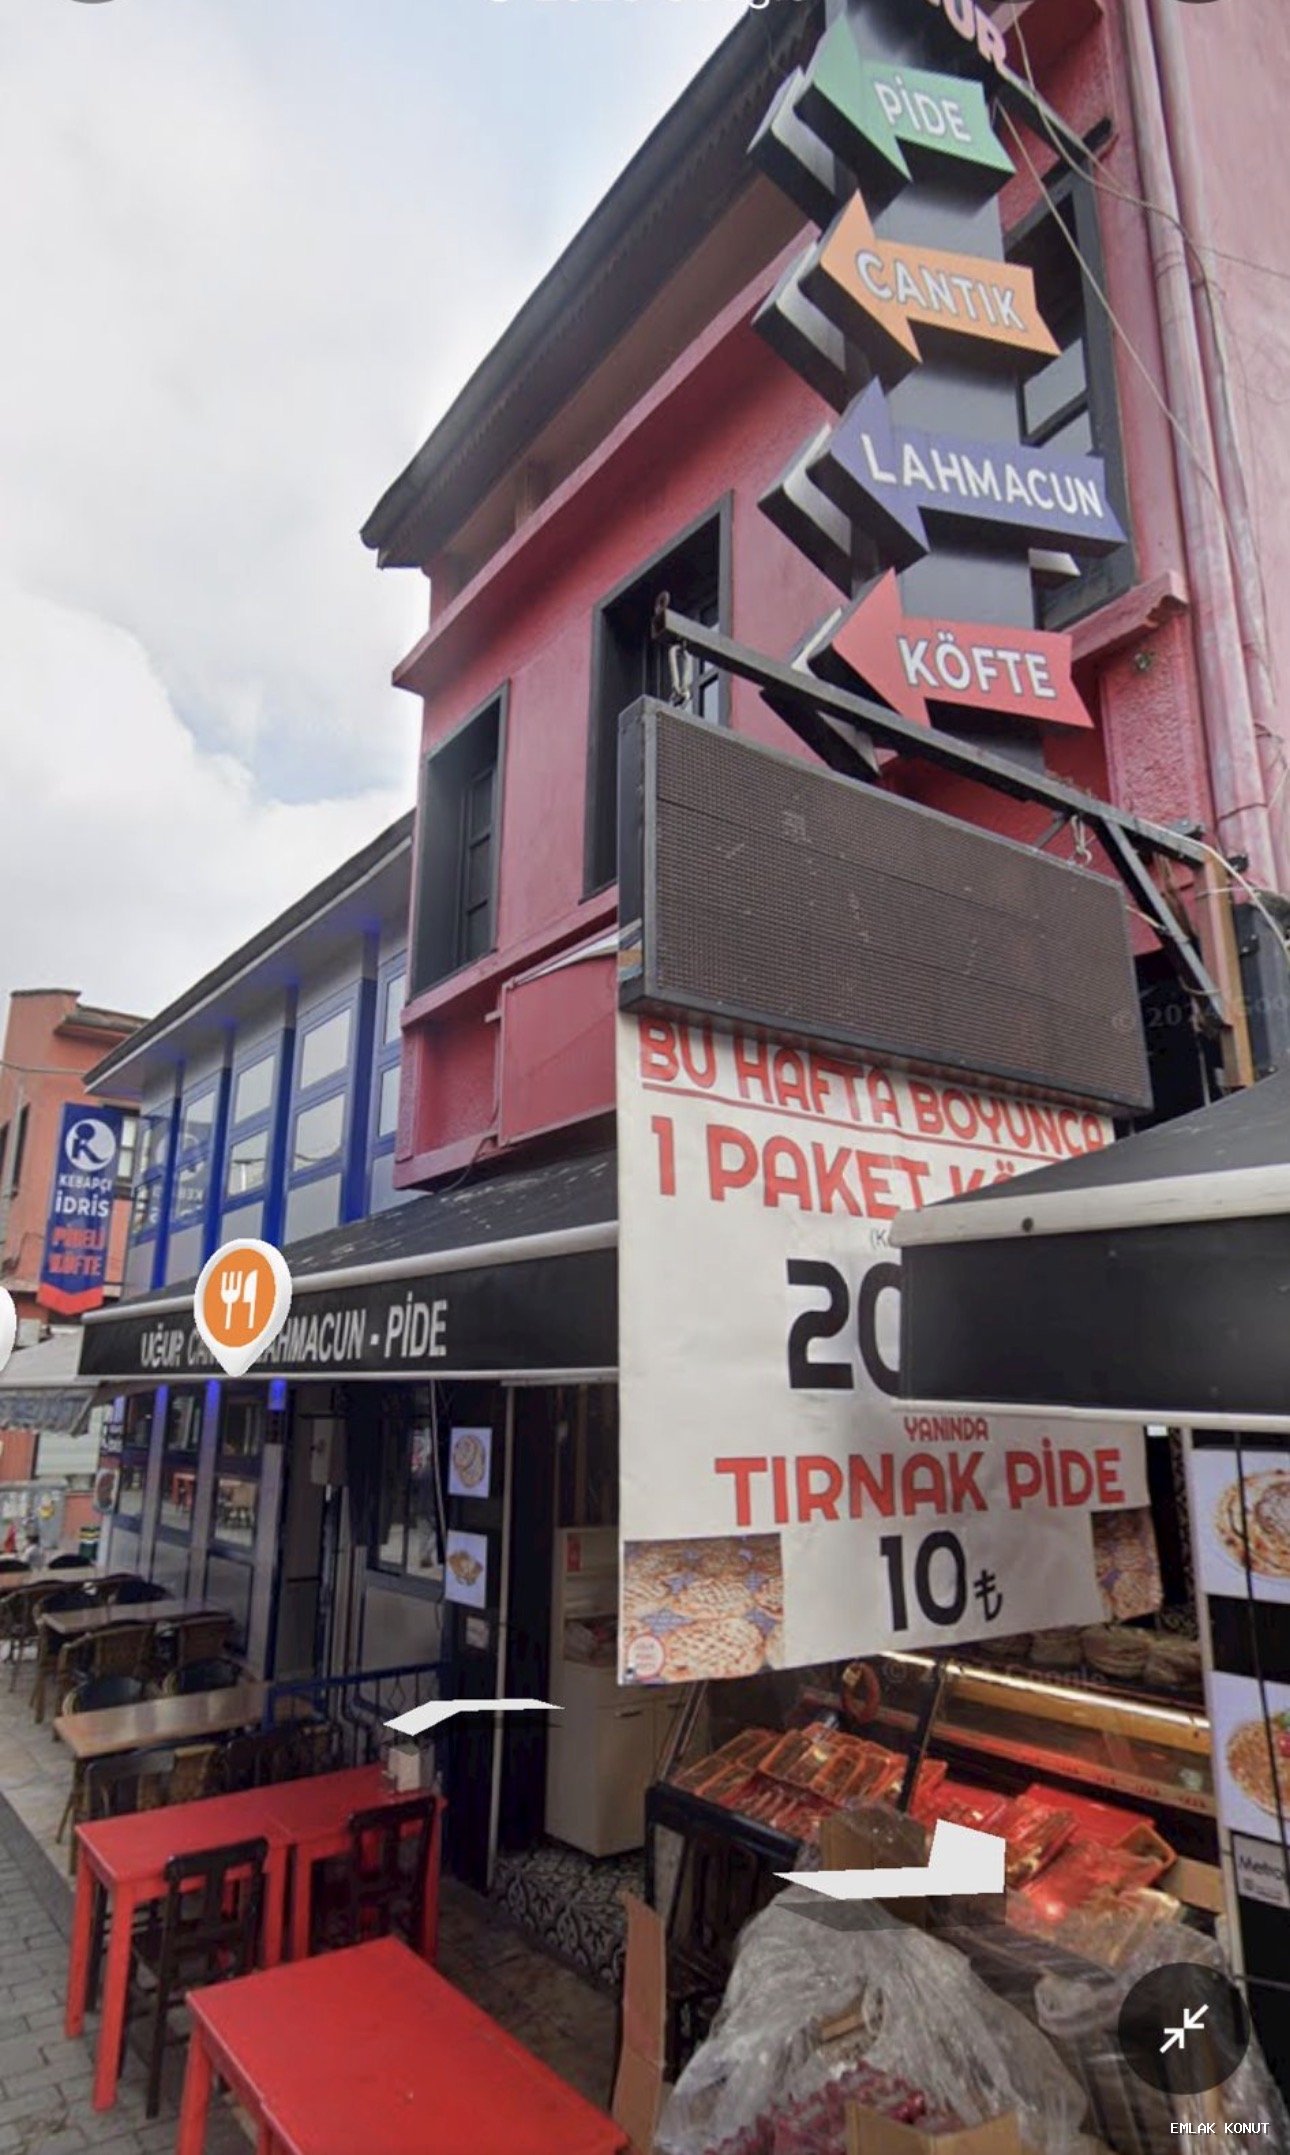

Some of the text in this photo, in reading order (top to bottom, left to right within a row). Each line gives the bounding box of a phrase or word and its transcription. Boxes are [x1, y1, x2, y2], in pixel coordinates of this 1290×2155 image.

[873, 77, 972, 143] PİDE
[856, 247, 1028, 331] CANTIK
[861, 433, 1104, 518] LAHMACUN
[897, 632, 1056, 699] KÖFTE
[638, 1016, 1107, 1160] BU HAFTA BOYUNCA
[55, 1189, 110, 1217] İDRİS
[651, 1115, 931, 1221] 1 PAKET
[384, 1291, 448, 1358] PİDE
[903, 1416, 989, 1442] YANINDA
[715, 1436, 1125, 1527] TIRNAK PİDE
